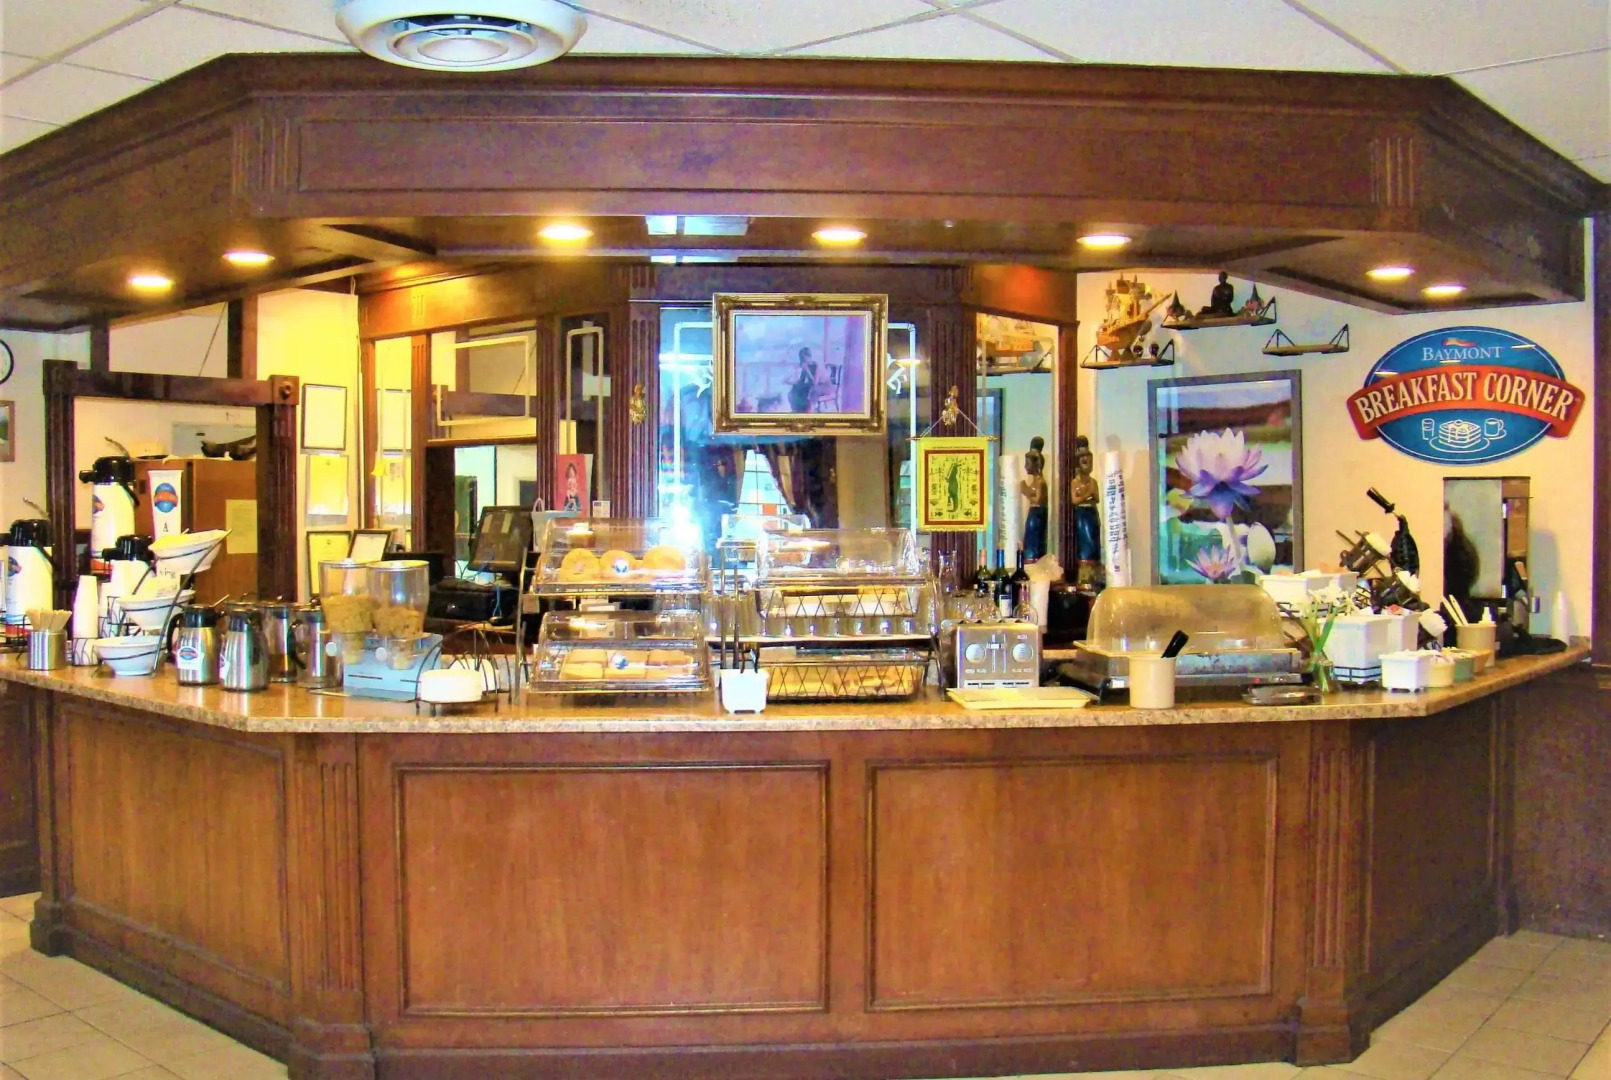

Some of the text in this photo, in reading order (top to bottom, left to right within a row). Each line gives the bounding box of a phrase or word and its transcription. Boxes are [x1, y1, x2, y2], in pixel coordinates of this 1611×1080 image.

[1422, 346, 1503, 361] BAYMONT
[1354, 372, 1574, 424] BREAKFAST CORNER
